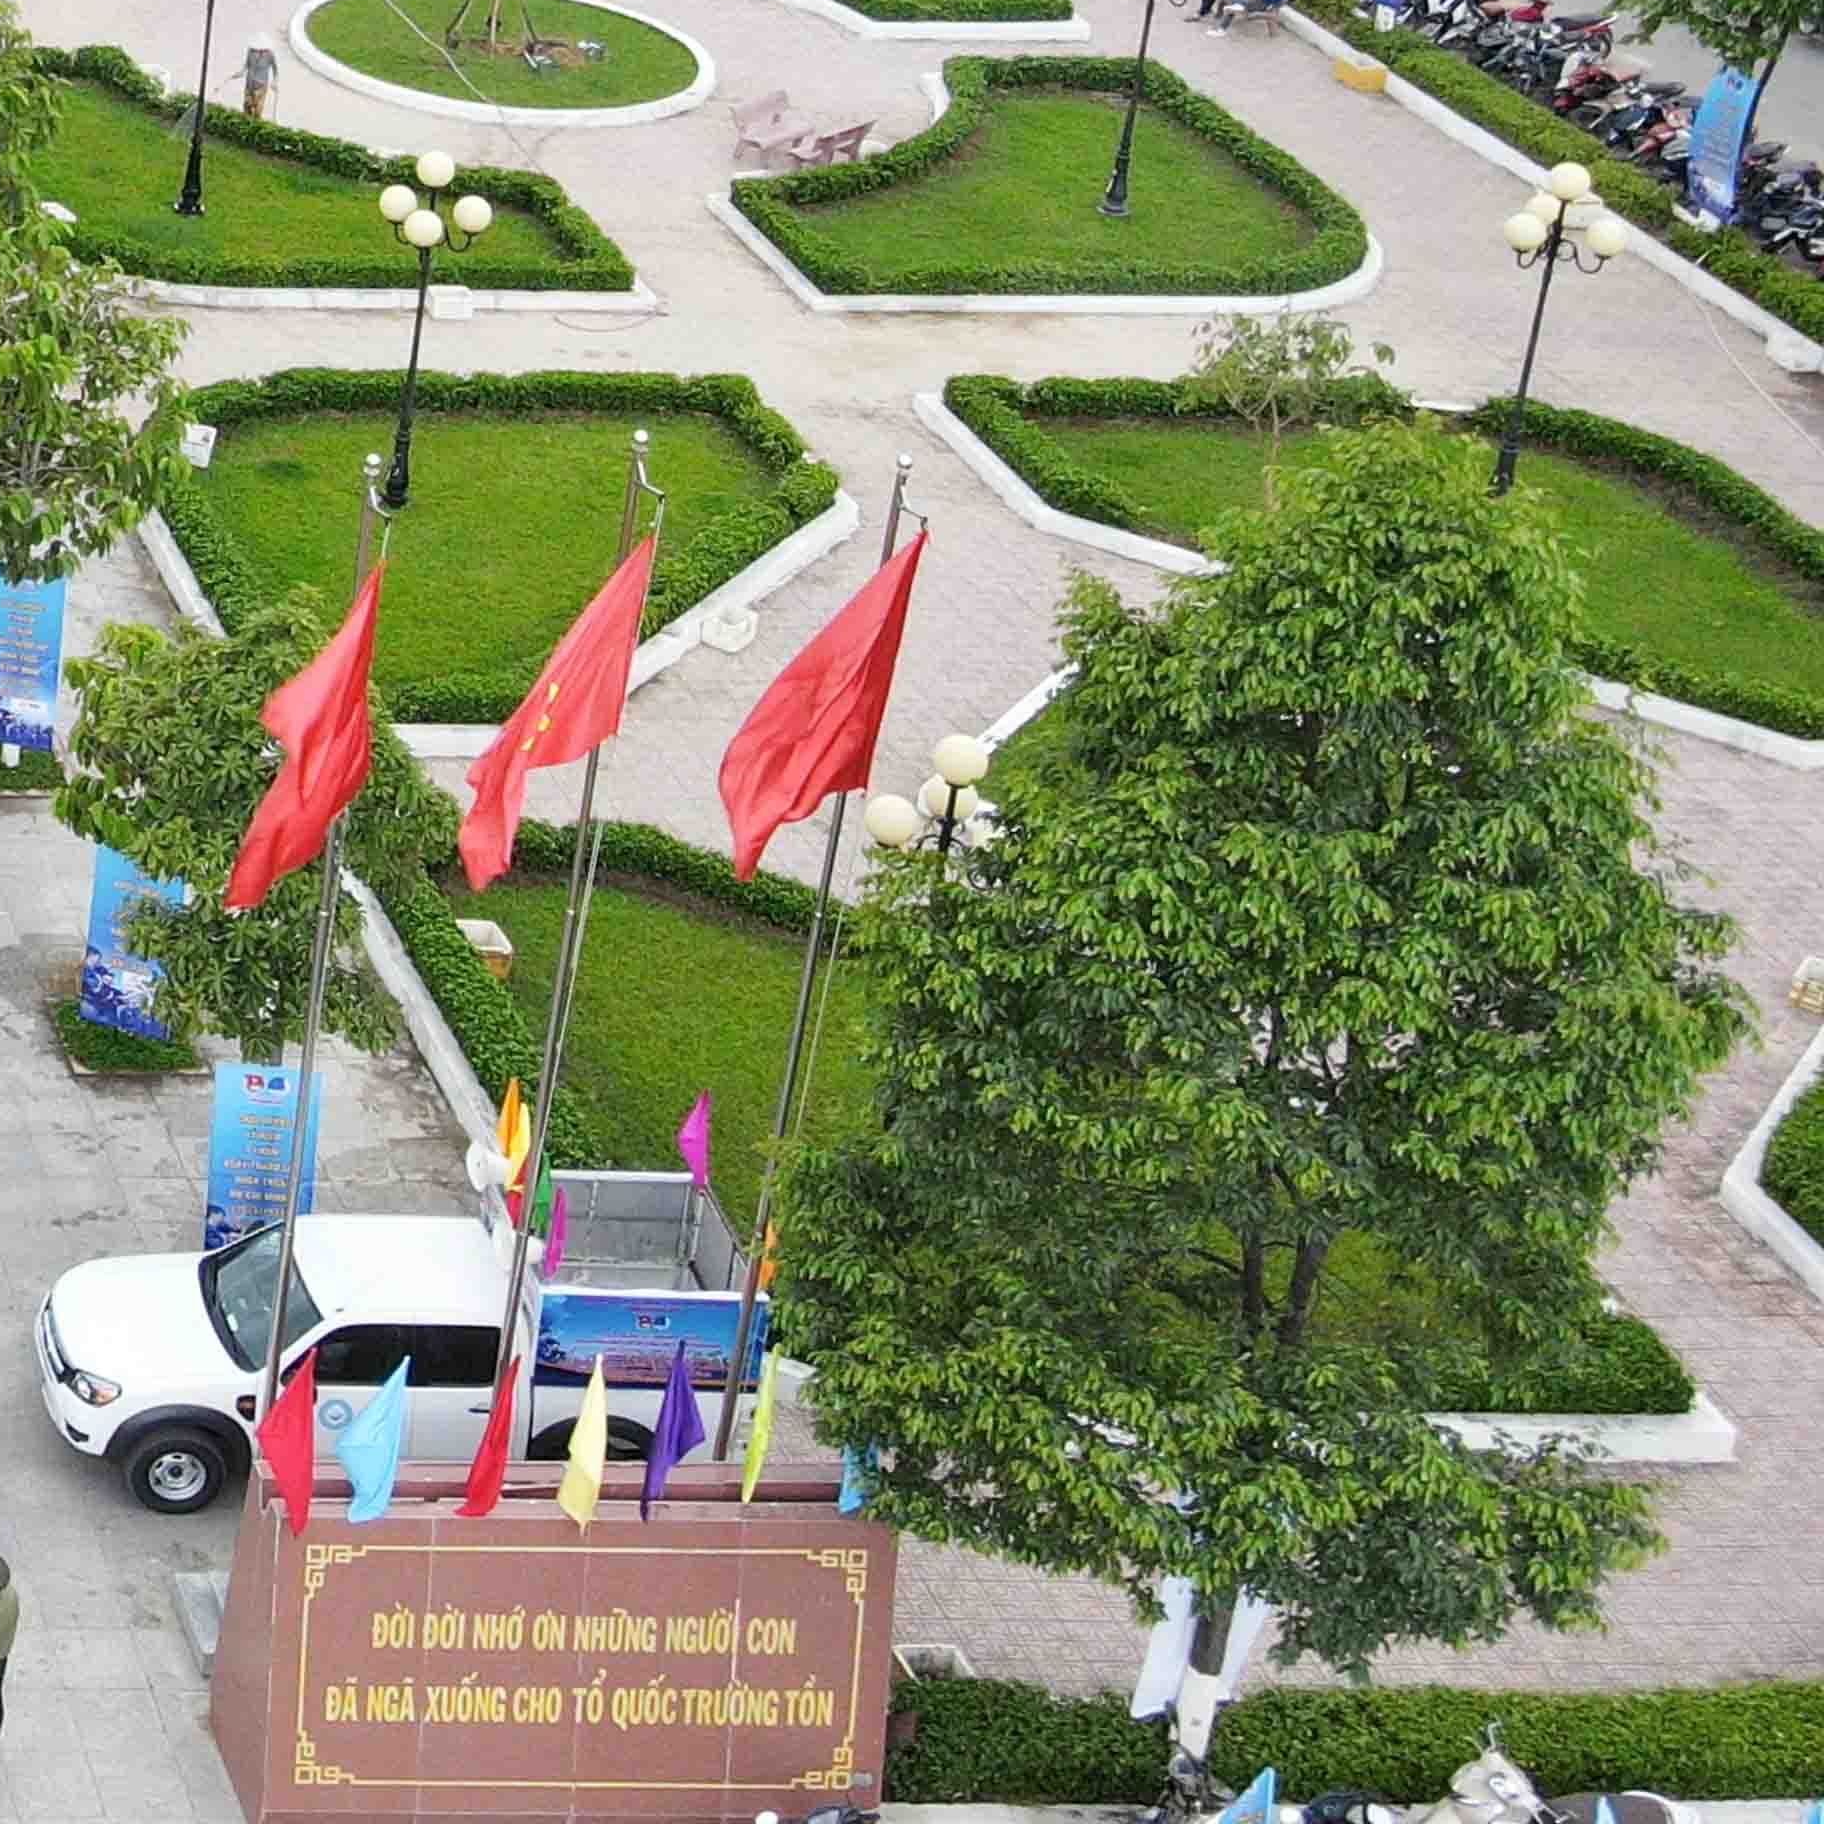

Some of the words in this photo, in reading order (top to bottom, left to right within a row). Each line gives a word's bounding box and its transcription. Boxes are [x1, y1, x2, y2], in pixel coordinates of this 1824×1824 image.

[371, 1602, 415, 1650] ĐỜI
[422, 1602, 465, 1651] ĐỜI
[473, 1604, 527, 1652] NHỚ
[532, 1612, 566, 1653] ƠN
[574, 1606, 657, 1654] NHỮNG
[665, 1608, 739, 1655] NGƯỜI
[747, 1618, 797, 1656] CON
[324, 1677, 360, 1724] ĐÃ
[366, 1677, 416, 1724] NGÃ
[424, 1670, 508, 1725] XUỐNG
[512, 1686, 563, 1726] CHO
[574, 1666, 608, 1726] TỔ
[611, 1673, 679, 1731] QUỐC
[683, 1676, 778, 1728] TRƯỜNG
[785, 1674, 835, 1728] TỒN
